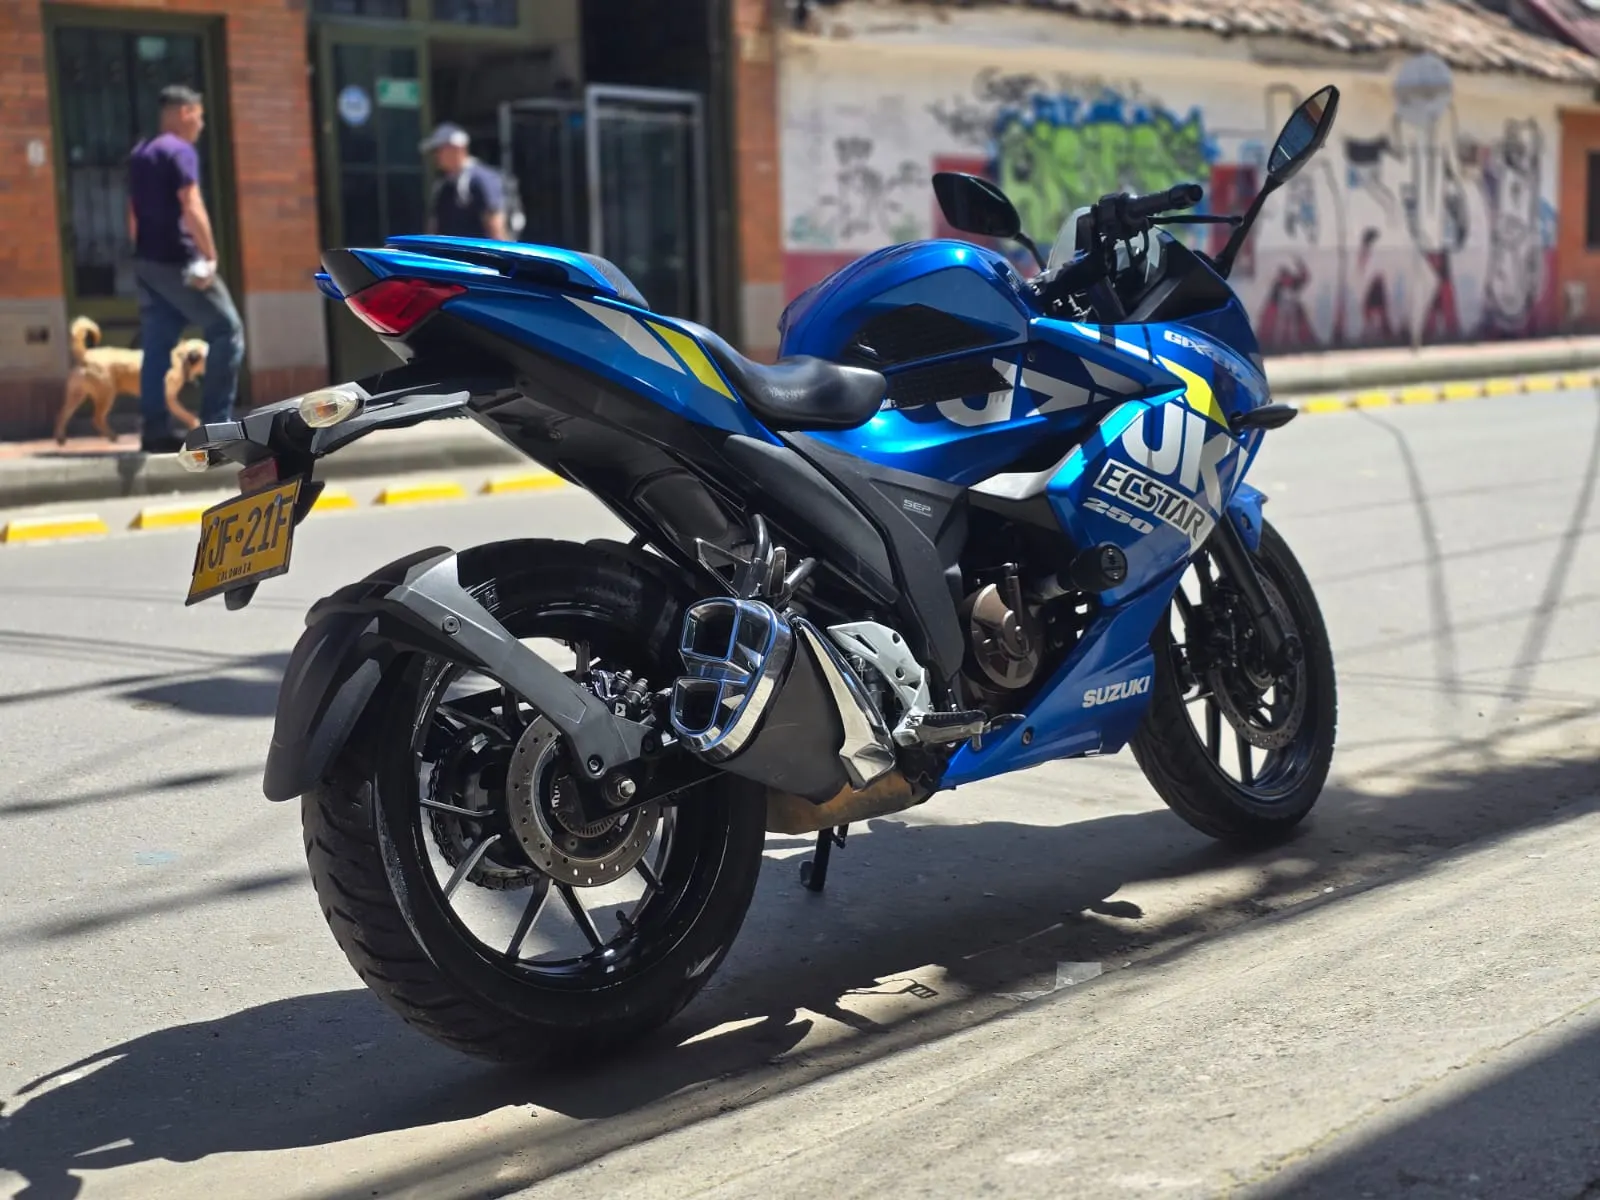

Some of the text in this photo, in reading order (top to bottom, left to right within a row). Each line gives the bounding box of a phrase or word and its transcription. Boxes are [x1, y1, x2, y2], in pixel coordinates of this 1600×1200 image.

[903, 499, 931, 512] SEP
[1083, 497, 1154, 534] 250
[1095, 461, 1209, 541] ECSTAR
[1082, 675, 1151, 709] SUZUKI
